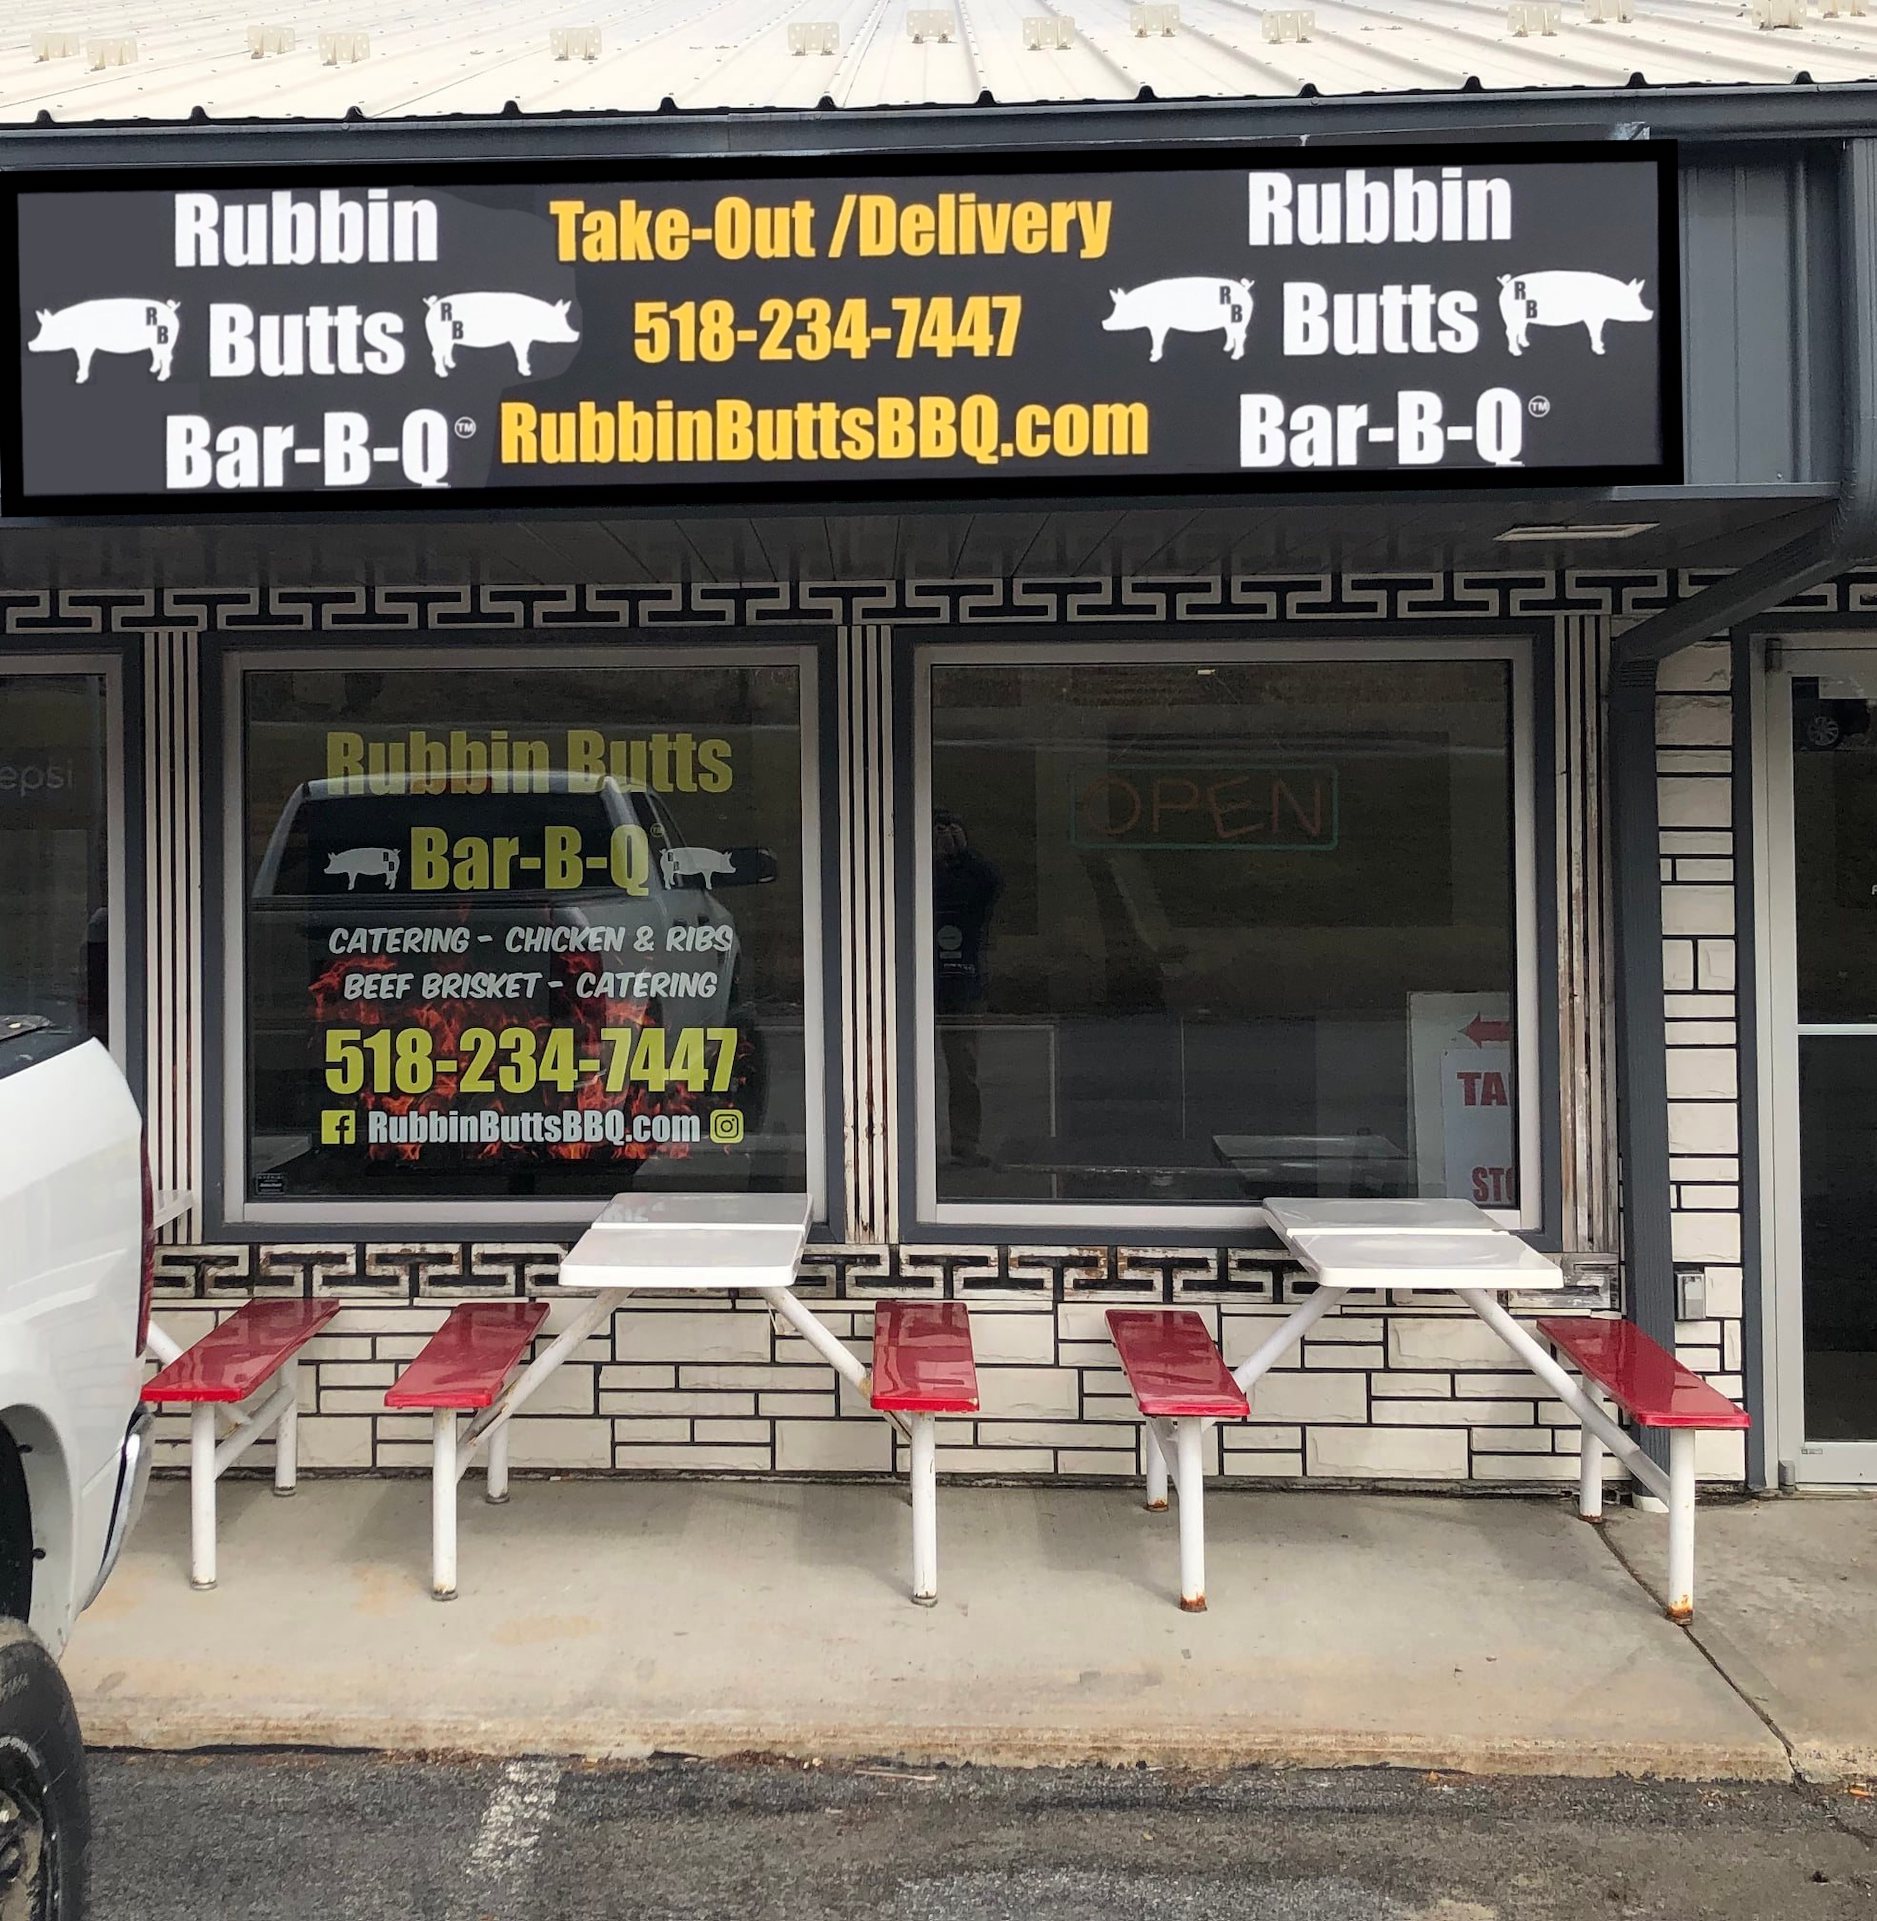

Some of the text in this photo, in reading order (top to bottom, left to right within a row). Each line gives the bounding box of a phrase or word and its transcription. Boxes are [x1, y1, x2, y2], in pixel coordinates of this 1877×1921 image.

[174, 189, 438, 267] Rubbin
[549, 193, 1112, 263] Take-Out /Delivery
[1248, 167, 1511, 246] Rubbin
[209, 303, 405, 378] Butts
[633, 295, 1022, 363] 518-234-7447
[1283, 281, 1479, 356] Butts
[166, 408, 451, 490] Bar-B-Q
[500, 394, 1150, 465] RubbinButtsBBQ.com
[1239, 387, 1525, 468] Bar-B-Q
[326, 729, 734, 796] Rubbin Butts
[1081, 774, 1322, 840] OPEN
[410, 823, 650, 897] Bar-B-Q
[328, 927, 469, 955] CATERING
[505, 925, 625, 954] CHICKEN
[633, 926, 655, 951] &
[666, 925, 733, 953] RIBS
[344, 972, 413, 1000] BEEF
[422, 972, 543, 1000] BRISKET
[576, 971, 719, 999] CATERING
[324, 1026, 738, 1094] 518-234-7447
[1456, 1071, 1512, 1106] TA
[368, 1109, 701, 1147] RubbinButtsBBQ.com
